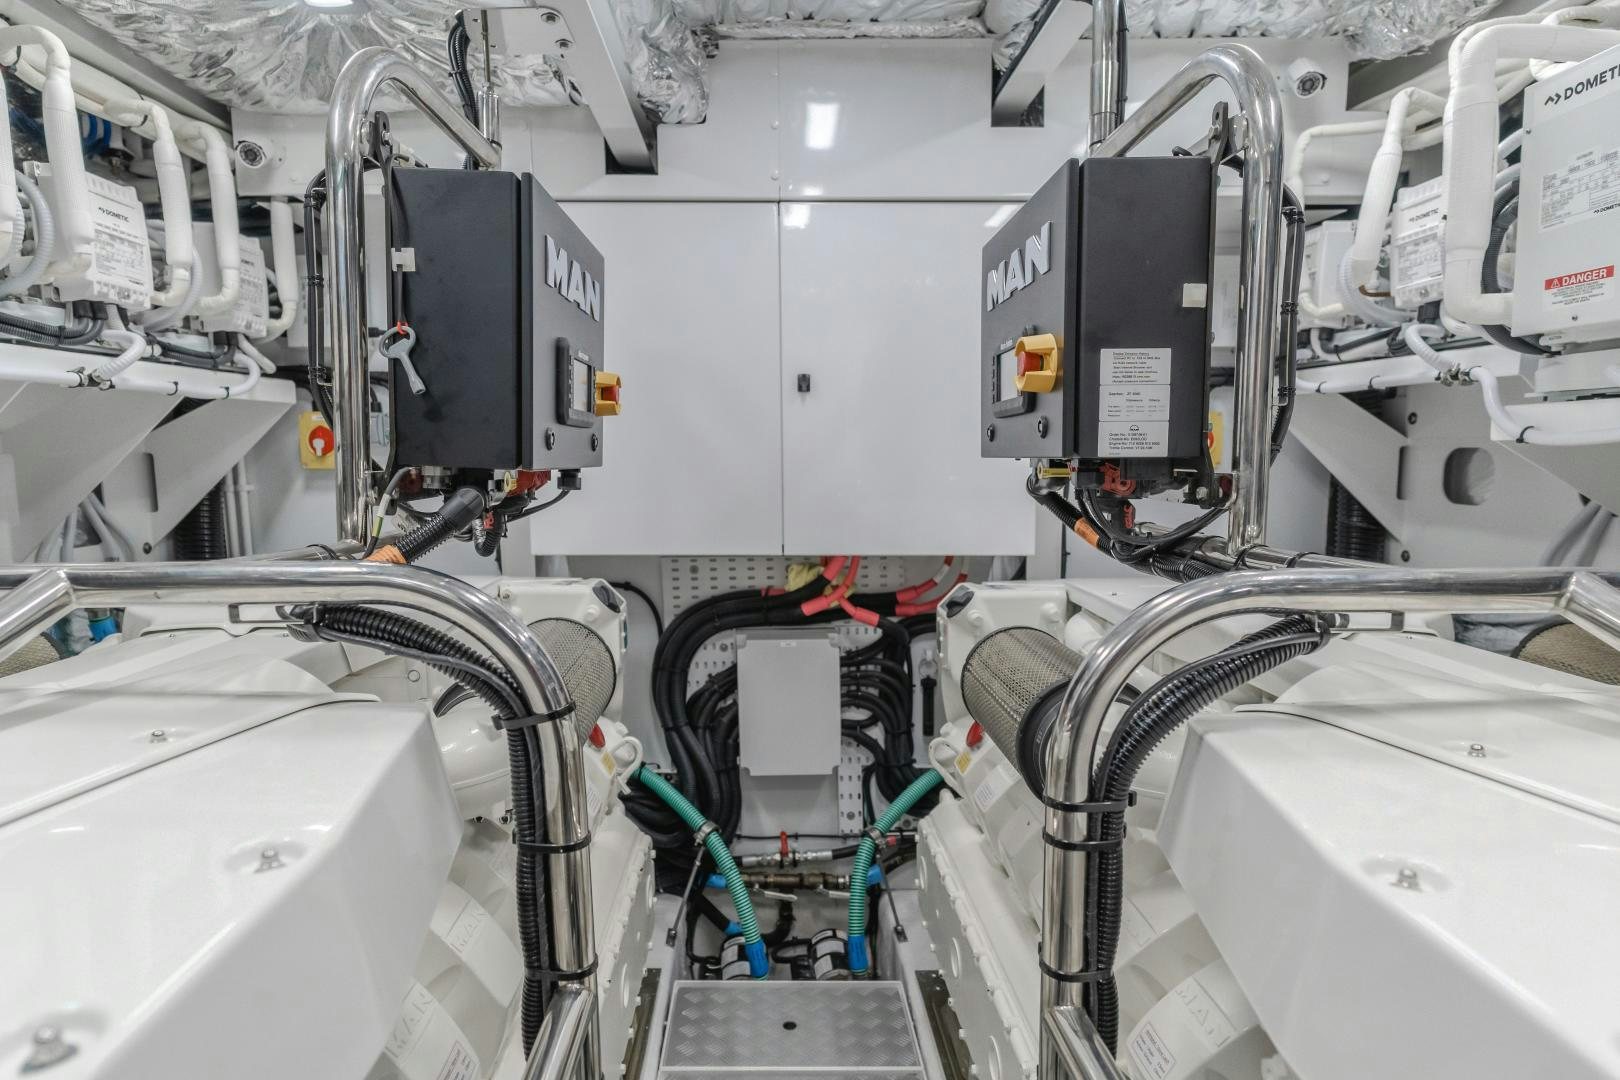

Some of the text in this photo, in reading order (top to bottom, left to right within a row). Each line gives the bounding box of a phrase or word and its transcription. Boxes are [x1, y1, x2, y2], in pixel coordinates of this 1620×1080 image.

[545, 234, 600, 322] MAN
[987, 221, 1051, 312] MAN
[1562, 268, 1607, 286] DANGER
